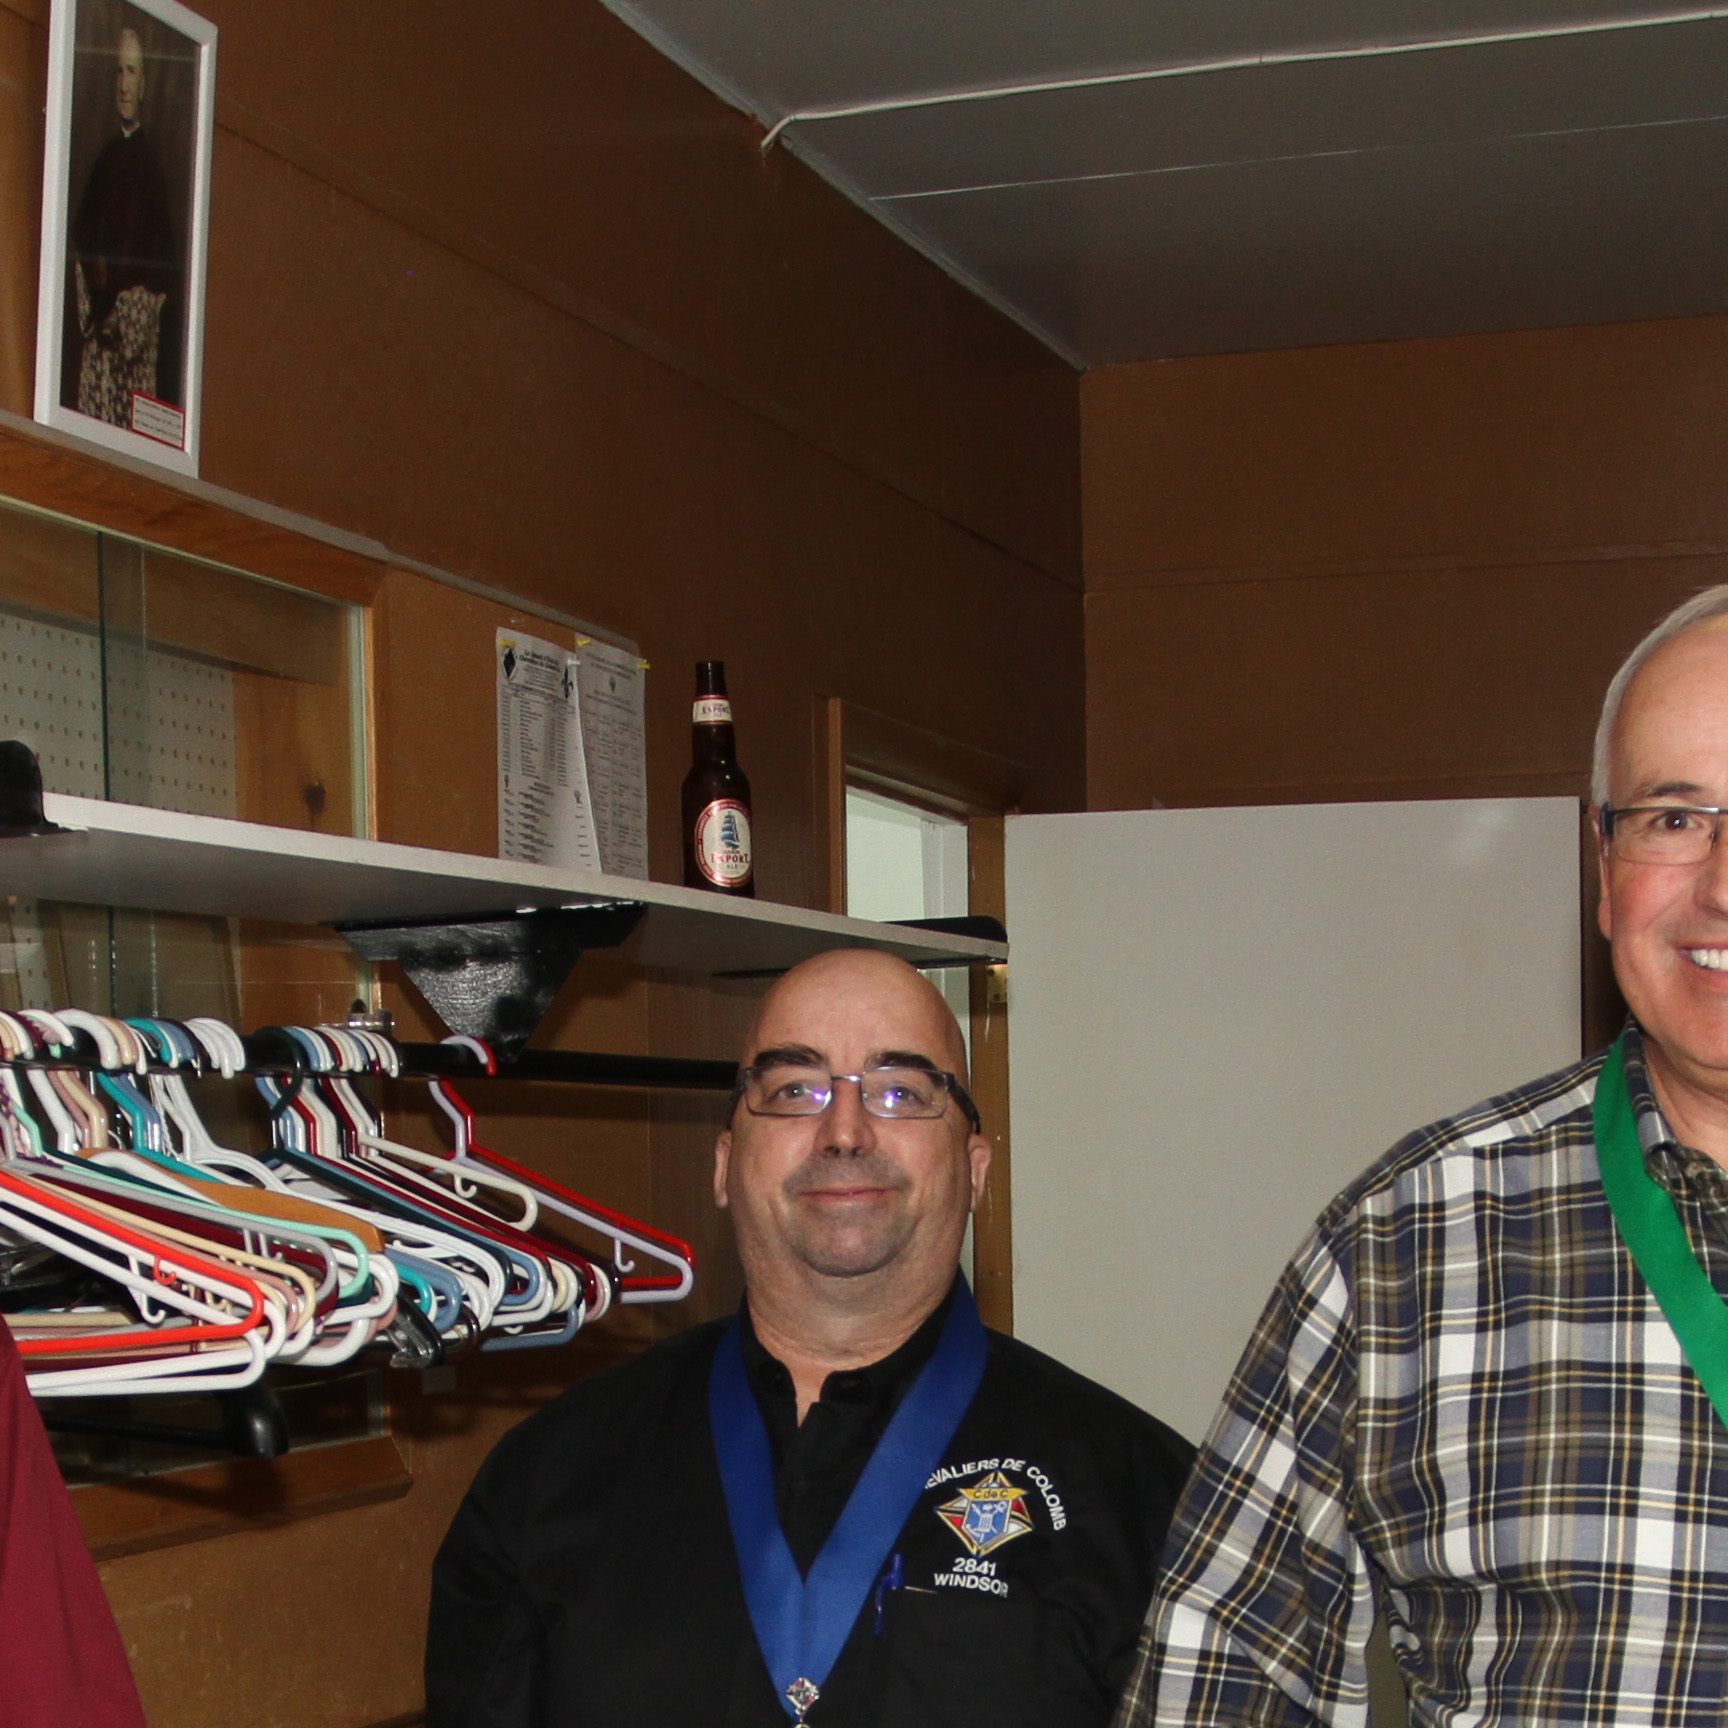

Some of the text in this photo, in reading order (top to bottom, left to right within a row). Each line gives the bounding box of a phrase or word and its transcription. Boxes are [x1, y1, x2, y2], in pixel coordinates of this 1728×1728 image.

[973, 1489, 982, 1499] C
[1000, 1489, 1009, 1499] C
[1001, 1458, 1026, 1472] DE
[1026, 1466, 1067, 1531] COLOMB
[952, 1557, 997, 1577] 2841
[933, 1572, 1009, 1599] WINDSOR
